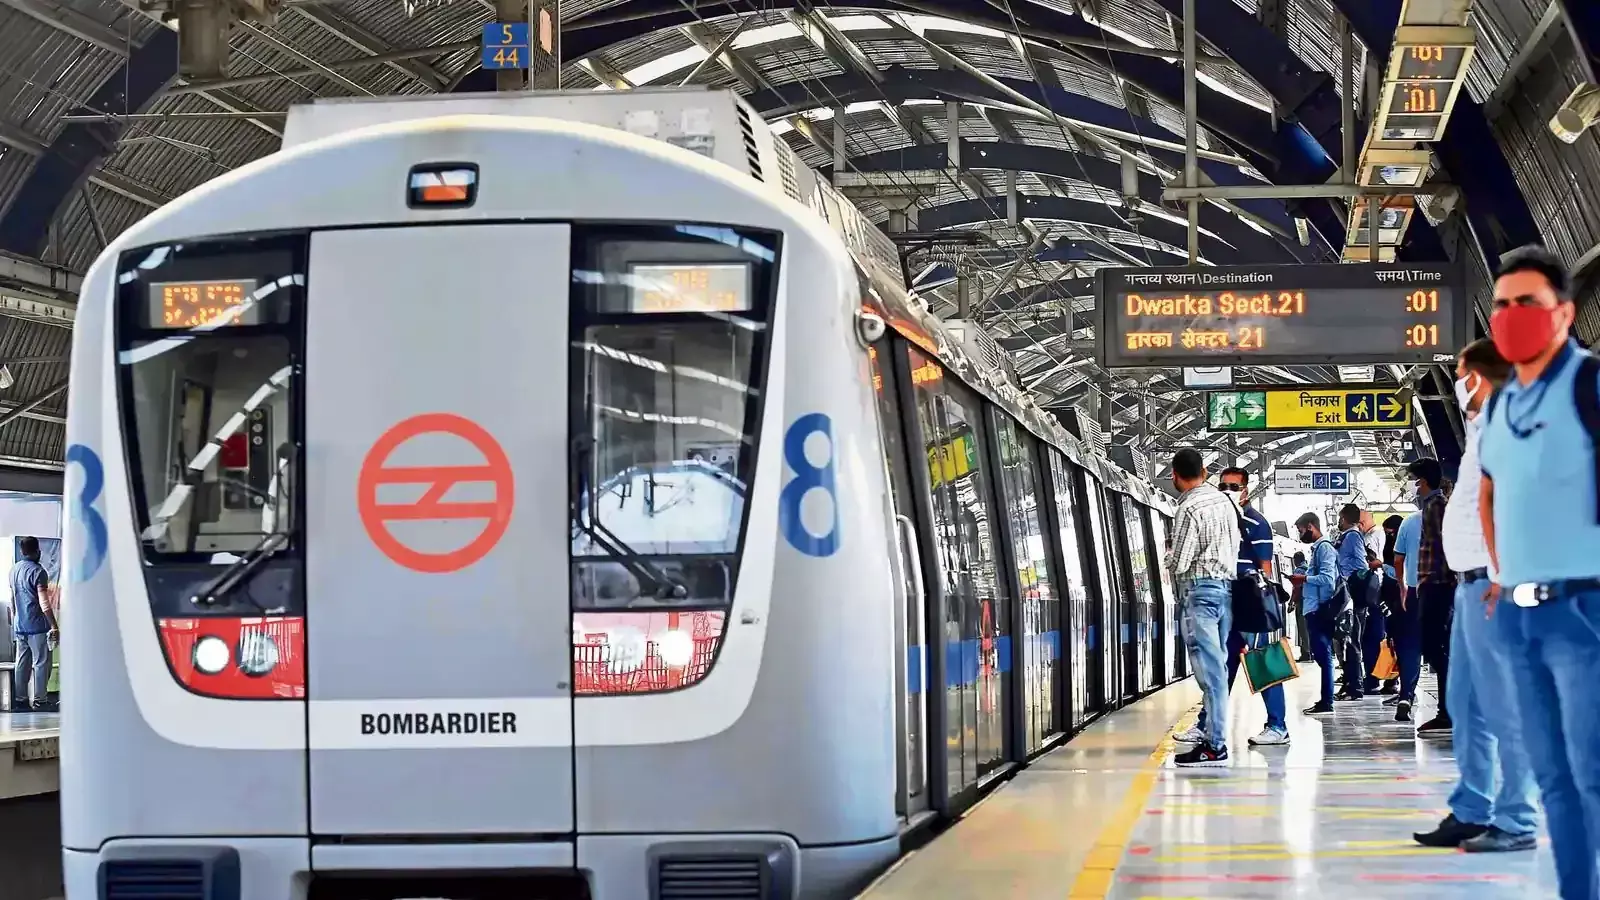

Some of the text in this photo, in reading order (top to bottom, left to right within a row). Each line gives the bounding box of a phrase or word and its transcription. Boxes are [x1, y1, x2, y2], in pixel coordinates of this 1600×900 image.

[502, 24, 512, 44] 5
[493, 48, 518, 67] 44
[1125, 274, 1161, 285] गन्तव्य
[1126, 291, 1304, 316] Dwarka Sect.21
[1406, 290, 1438, 312] :01
[1126, 327, 1263, 350] द्वारका सेक्टर 21
[1406, 324, 1438, 346] :01
[1299, 391, 1340, 407] निकास
[1315, 411, 1341, 424] Exit
[779, 413, 840, 558] 8
[361, 712, 517, 735] BOMBARDIER
